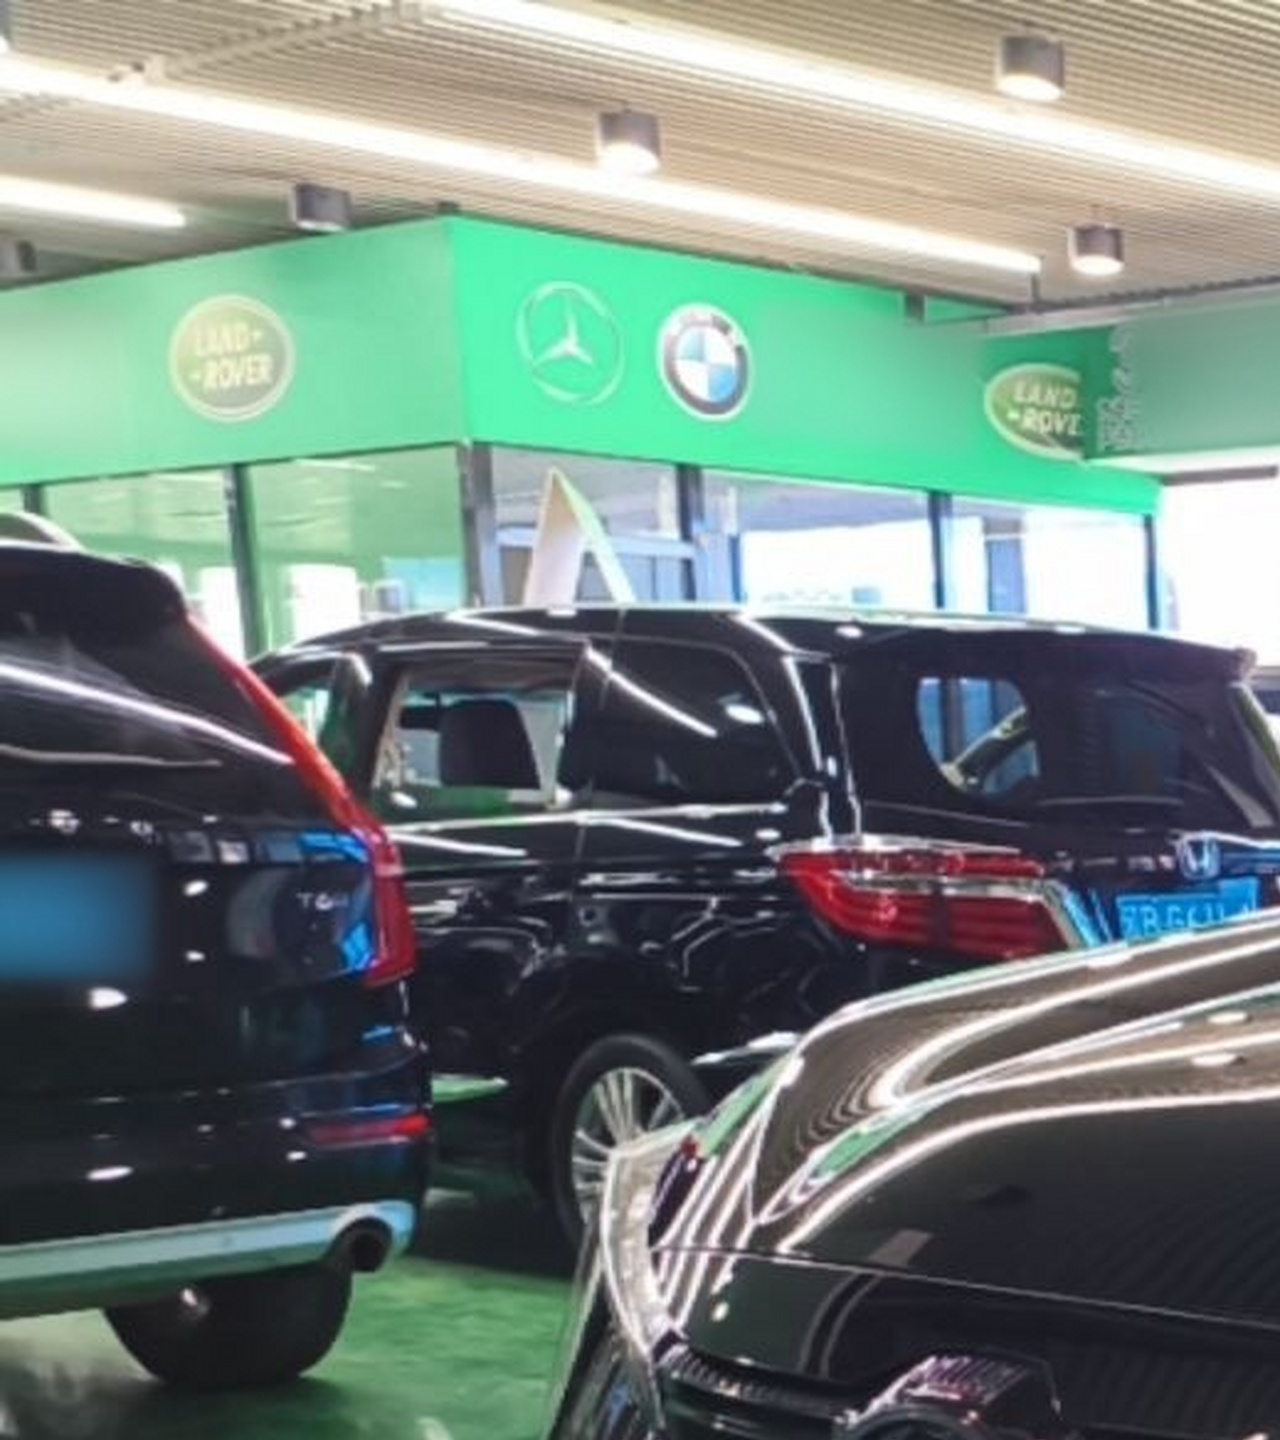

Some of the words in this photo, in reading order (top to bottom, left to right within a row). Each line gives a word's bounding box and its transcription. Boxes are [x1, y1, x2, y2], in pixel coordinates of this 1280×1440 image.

[194, 321, 250, 358] LAND
[203, 353, 273, 393] ROVER
[1013, 380, 1078, 410] LAND
[1021, 407, 1085, 436] ROVE
